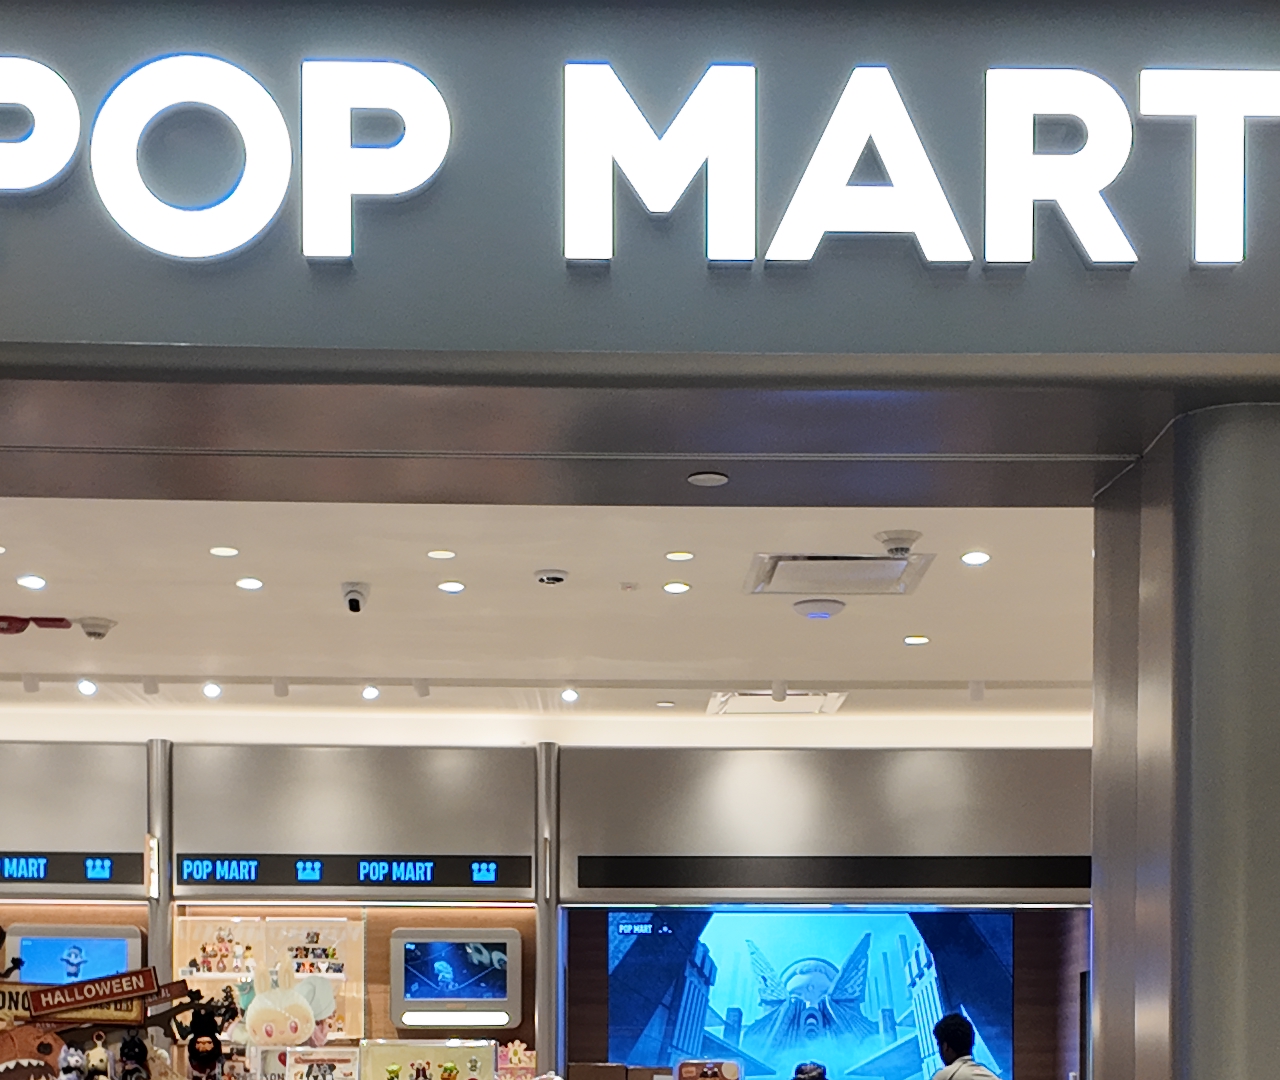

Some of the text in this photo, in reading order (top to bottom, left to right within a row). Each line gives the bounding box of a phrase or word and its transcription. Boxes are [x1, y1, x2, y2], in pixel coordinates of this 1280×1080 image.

[4, 857, 47, 879] MART
[182, 860, 258, 881] POP MART
[359, 861, 434, 882] POP MART
[40, 975, 145, 1008] HALLOWEEN
